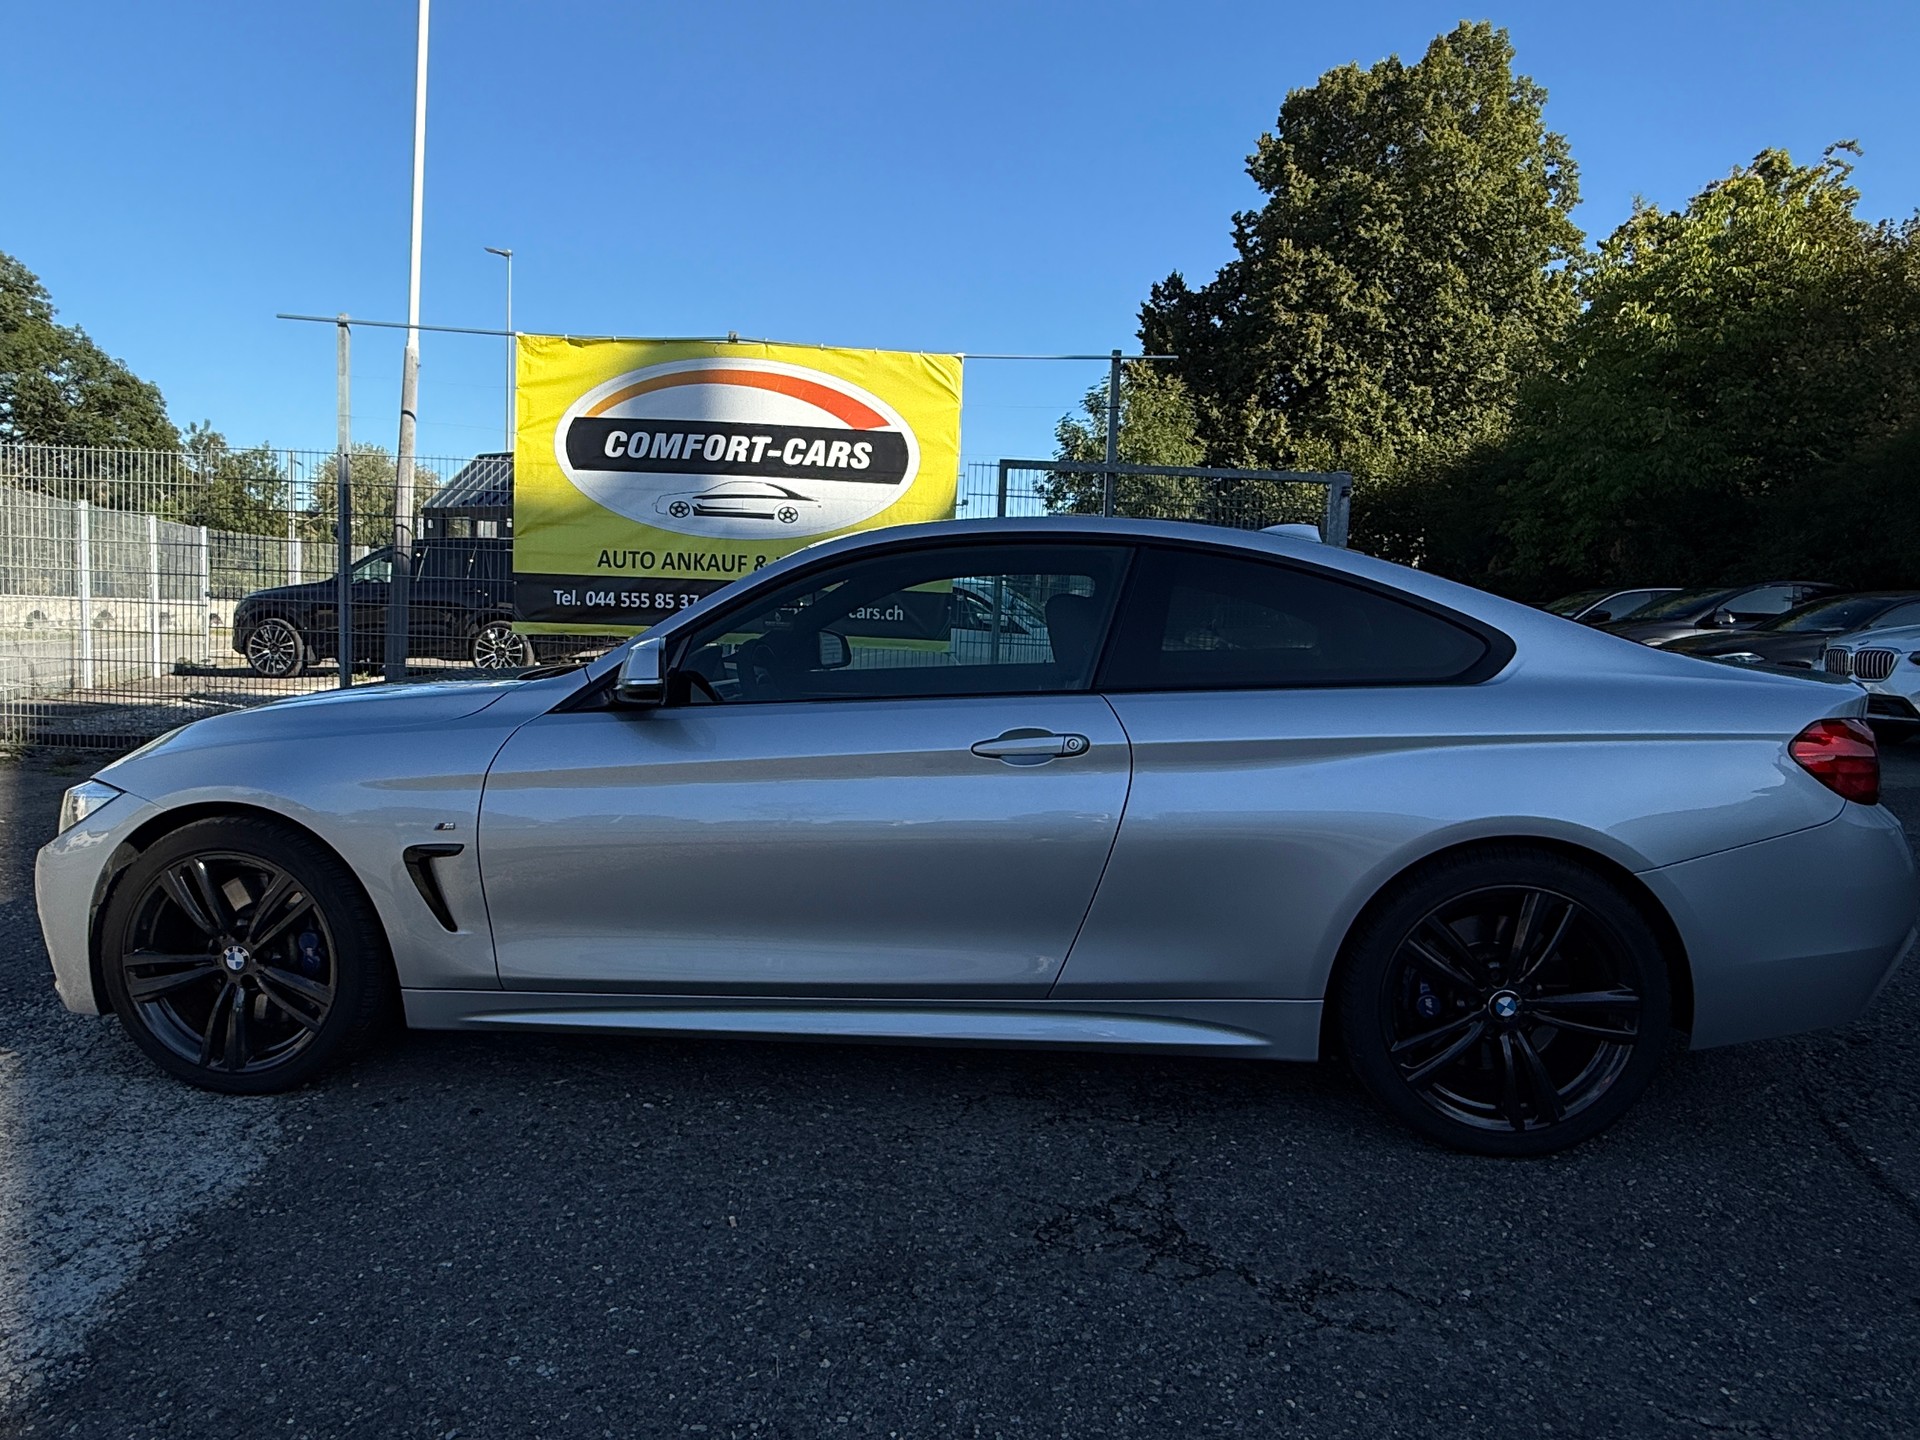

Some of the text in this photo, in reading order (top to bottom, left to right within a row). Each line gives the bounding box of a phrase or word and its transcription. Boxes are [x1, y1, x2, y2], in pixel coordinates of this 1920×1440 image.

[604, 430, 873, 470] COMFORT-CARS
[597, 549, 767, 573] AUTO ANKAUF &
[553, 589, 699, 609] Tel. 044 555 85 37
